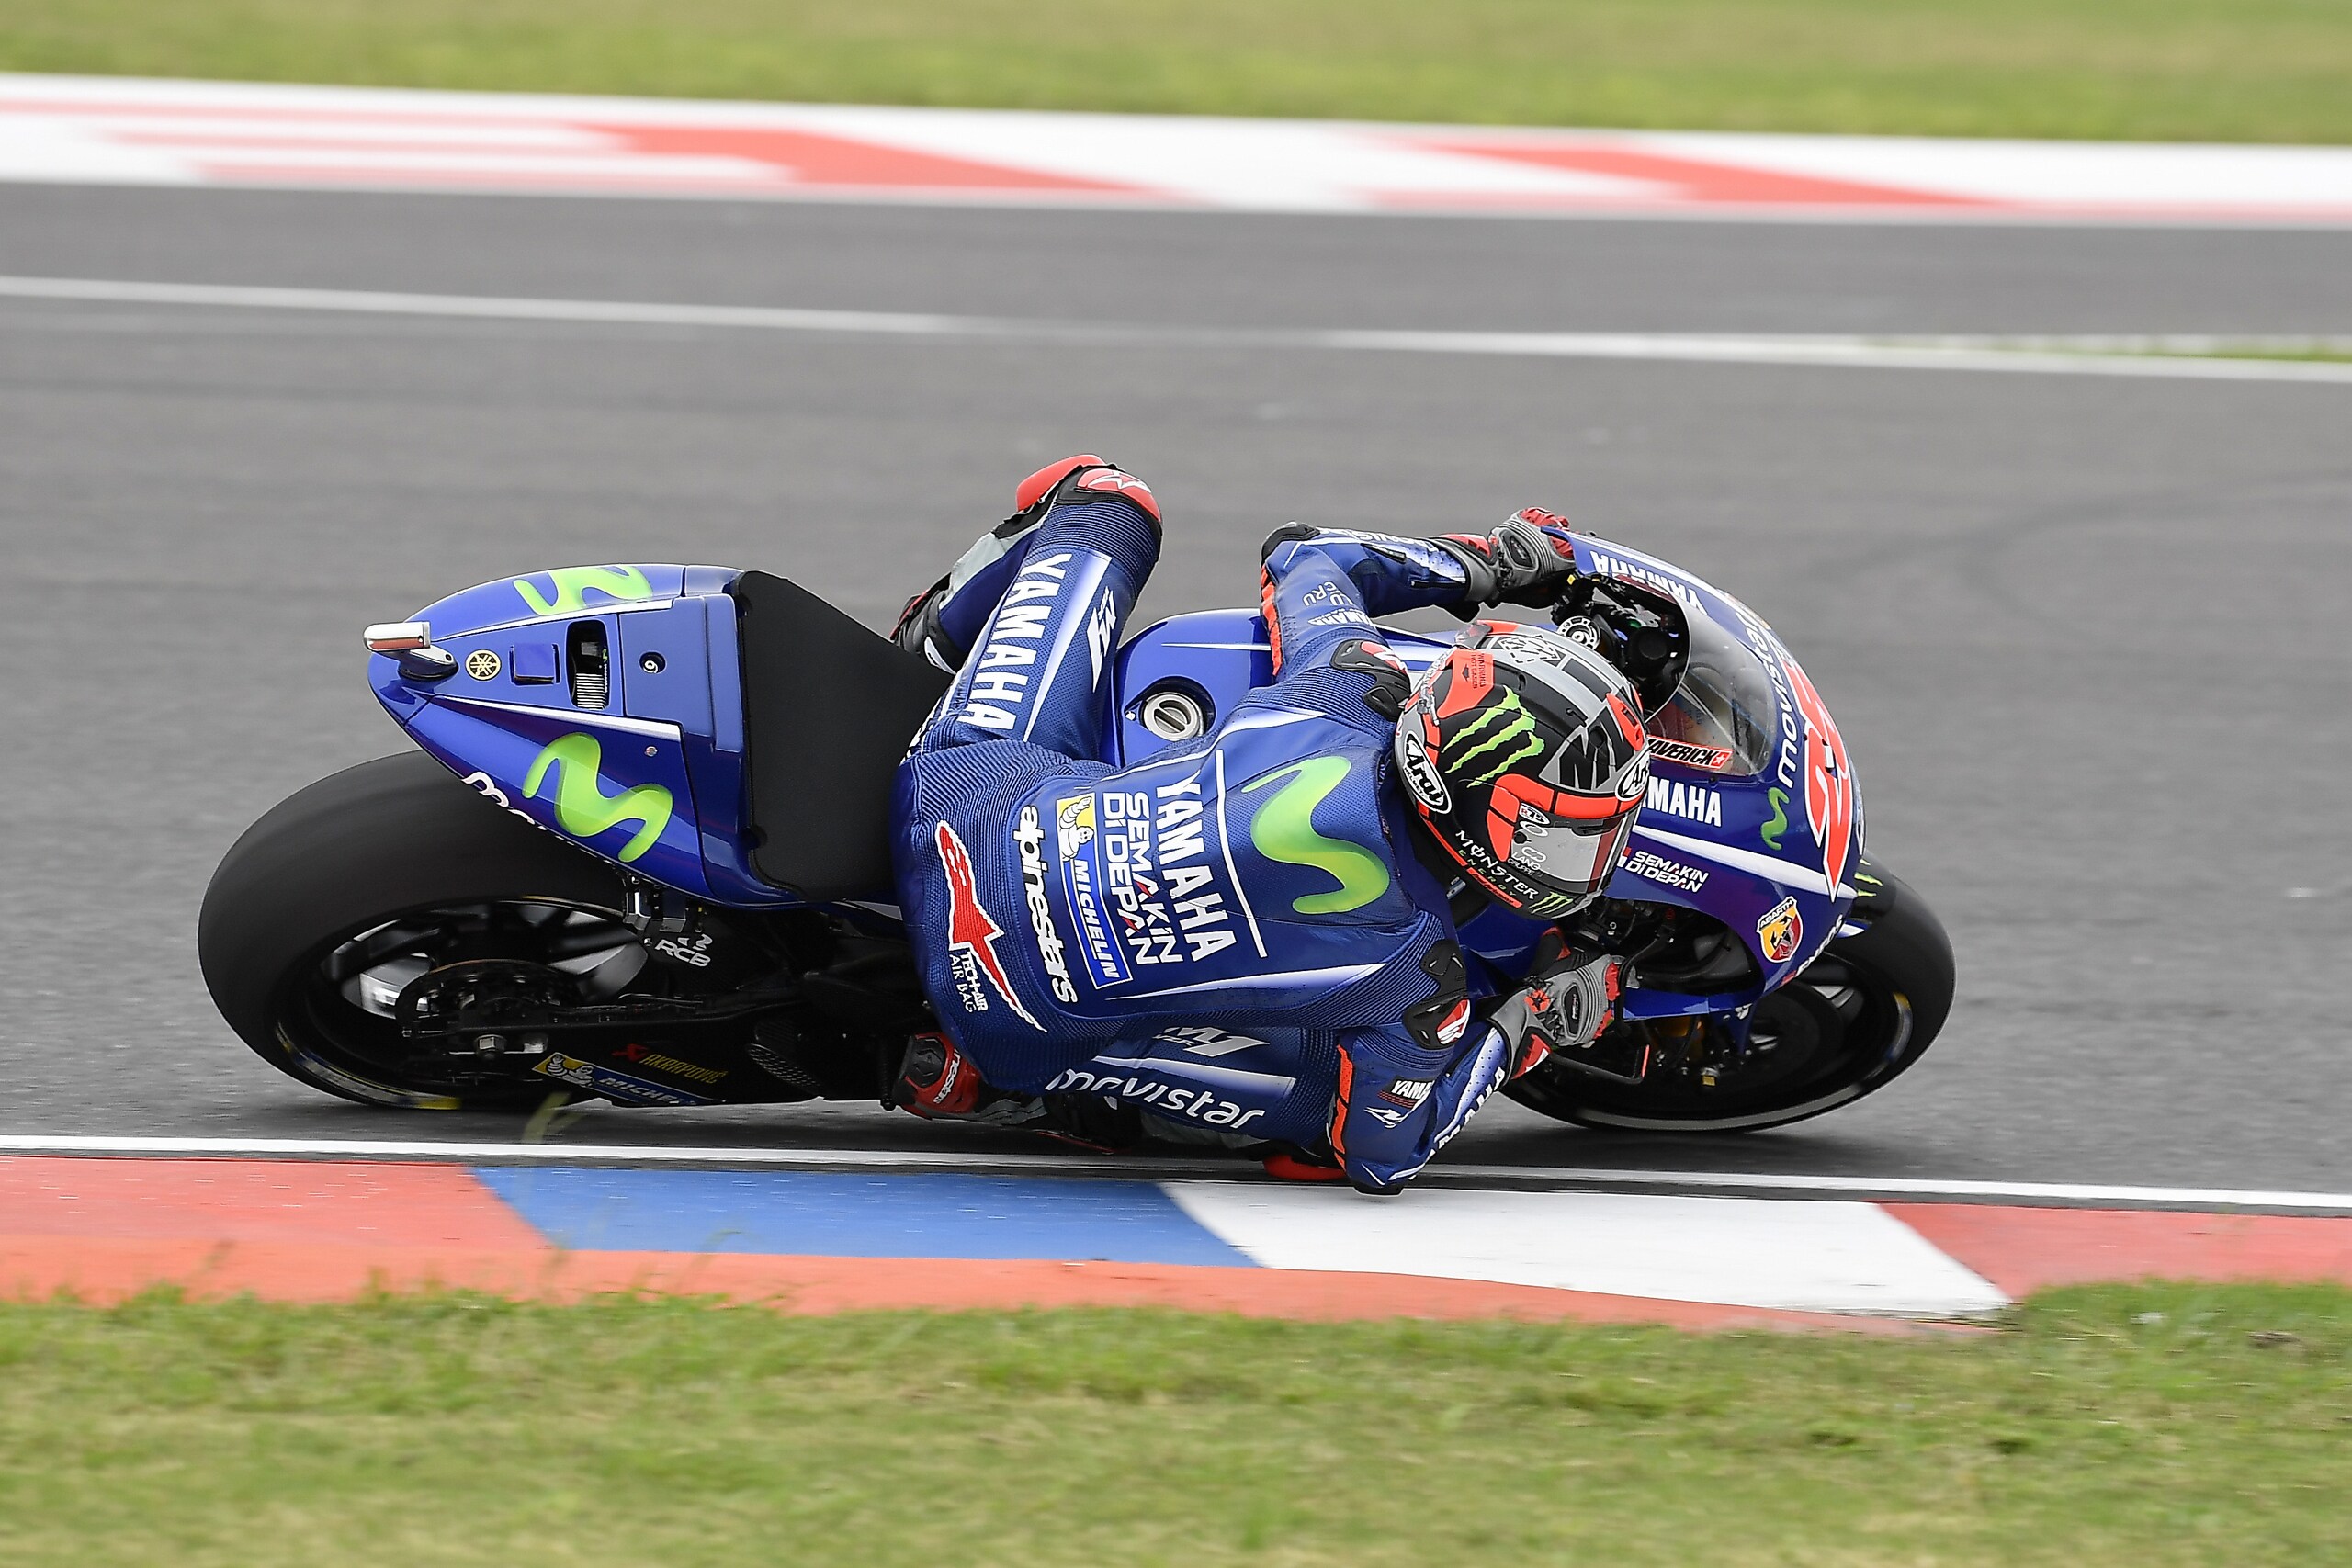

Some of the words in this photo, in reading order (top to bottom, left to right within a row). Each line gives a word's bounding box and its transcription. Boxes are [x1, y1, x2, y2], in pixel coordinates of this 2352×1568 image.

[957, 553, 1072, 730] YAMAHA
[1736, 612, 1797, 789] movistar
[1647, 738, 1718, 766] AVERICK
[1407, 753, 1445, 804] Arai
[1643, 775, 1722, 828] MAHA
[1126, 792, 1184, 964] SEMAKIN
[1156, 773, 1237, 962] YAMAHA
[1455, 830, 1540, 900] MONSTER
[1458, 849, 1517, 897] ENERGY
[1633, 851, 1709, 883] SEMAKIN
[1073, 859, 1121, 978] MICHELIN
[1760, 899, 1793, 928] ABARTH
[655, 939, 711, 967] RCB
[949, 954, 965, 980] AIR
